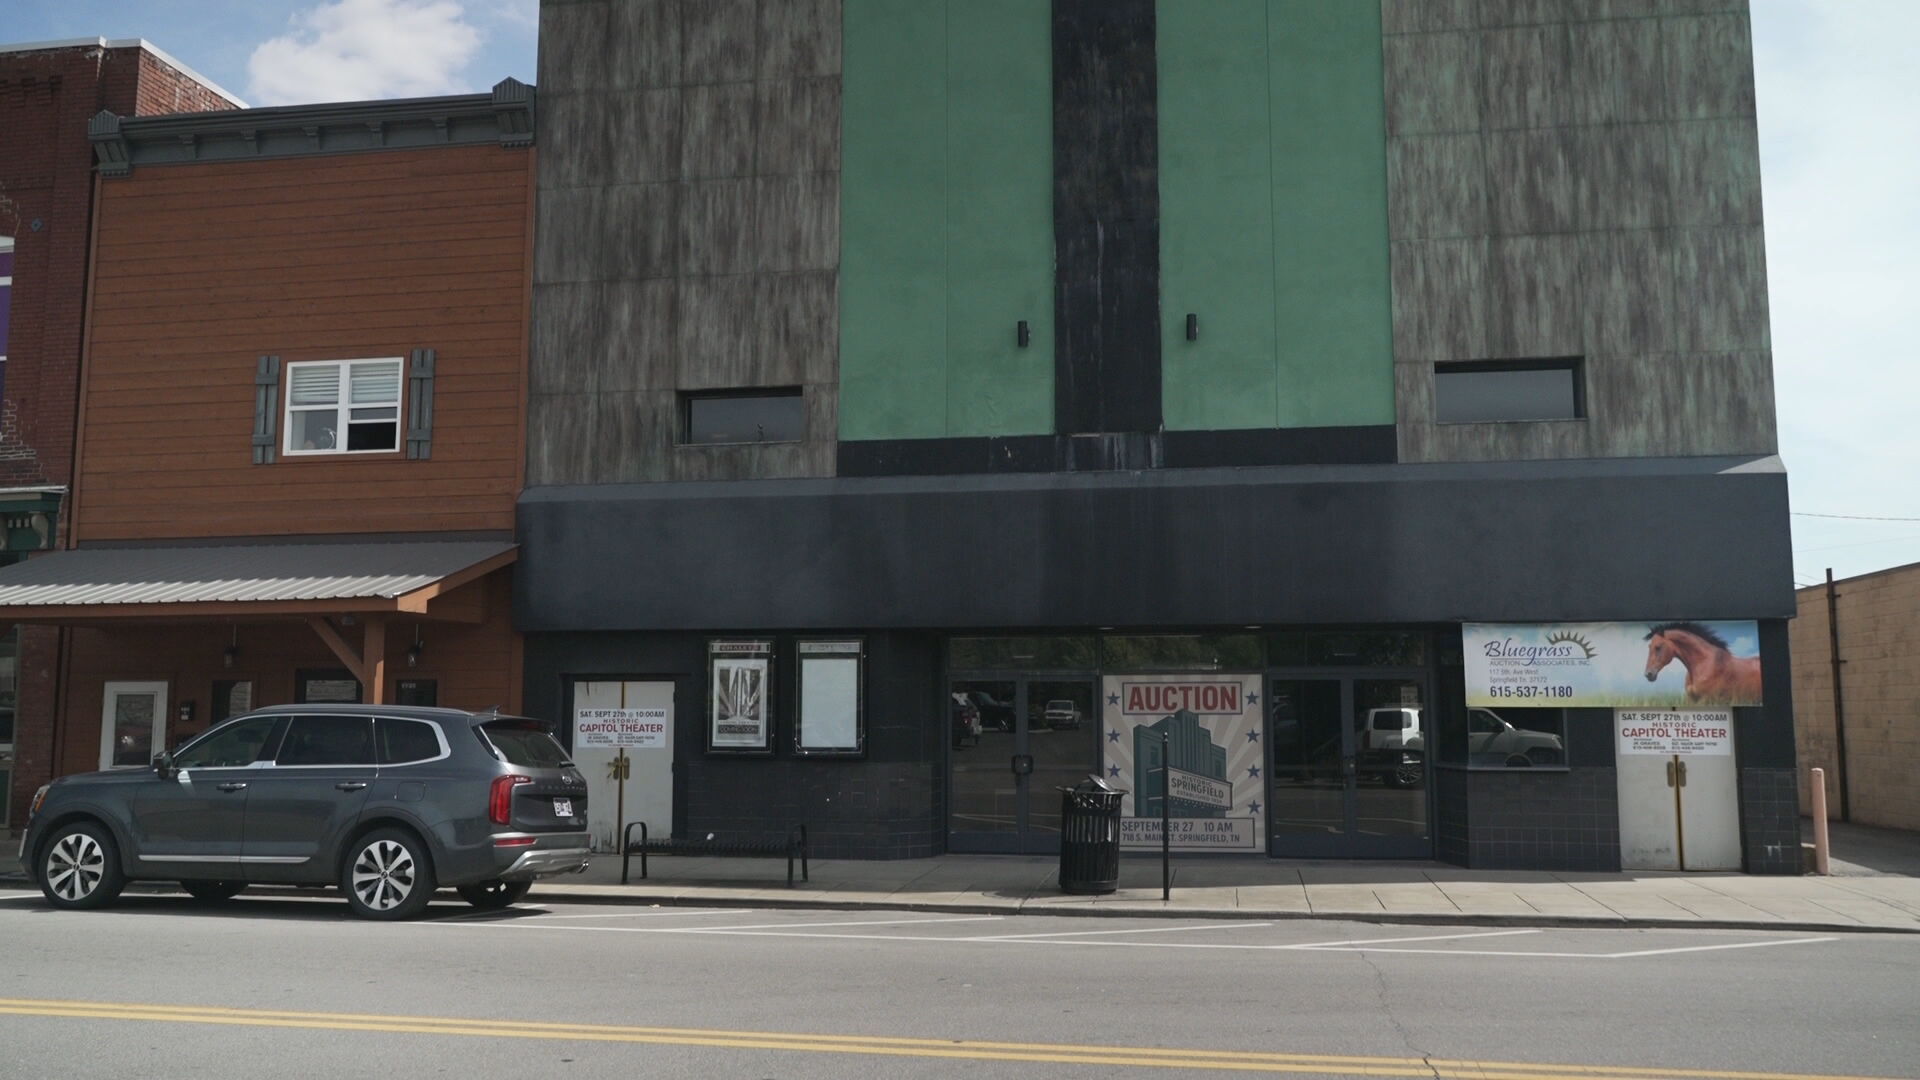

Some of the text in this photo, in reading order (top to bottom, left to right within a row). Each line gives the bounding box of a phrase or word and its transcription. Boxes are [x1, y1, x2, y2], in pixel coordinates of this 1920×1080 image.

[1484, 637, 1572, 666] Bluegrass
[1490, 685, 1573, 698] 615-537-1180
[1128, 686, 1237, 711] AUCTION
[580, 710, 593, 718] SAT.
[1622, 713, 1638, 721] SAT.
[1640, 713, 1661, 721] SEPT
[1663, 713, 1681, 721] 27th
[1692, 714, 1728, 722] 10:00AM
[579, 723, 664, 733] CAPITOL THEATER
[1622, 728, 1727, 738] CAPITOL THEATER
[1181, 775, 1212, 788] HISTORIC
[1171, 777, 1224, 799] SPRINGFIELD
[1122, 821, 1233, 832] SEPTEMER 27 10 AM
[1145, 833, 1164, 842] MAIN
[1178, 834, 1229, 844] SPRINGFIELD,
[1231, 834, 1240, 843] TN
